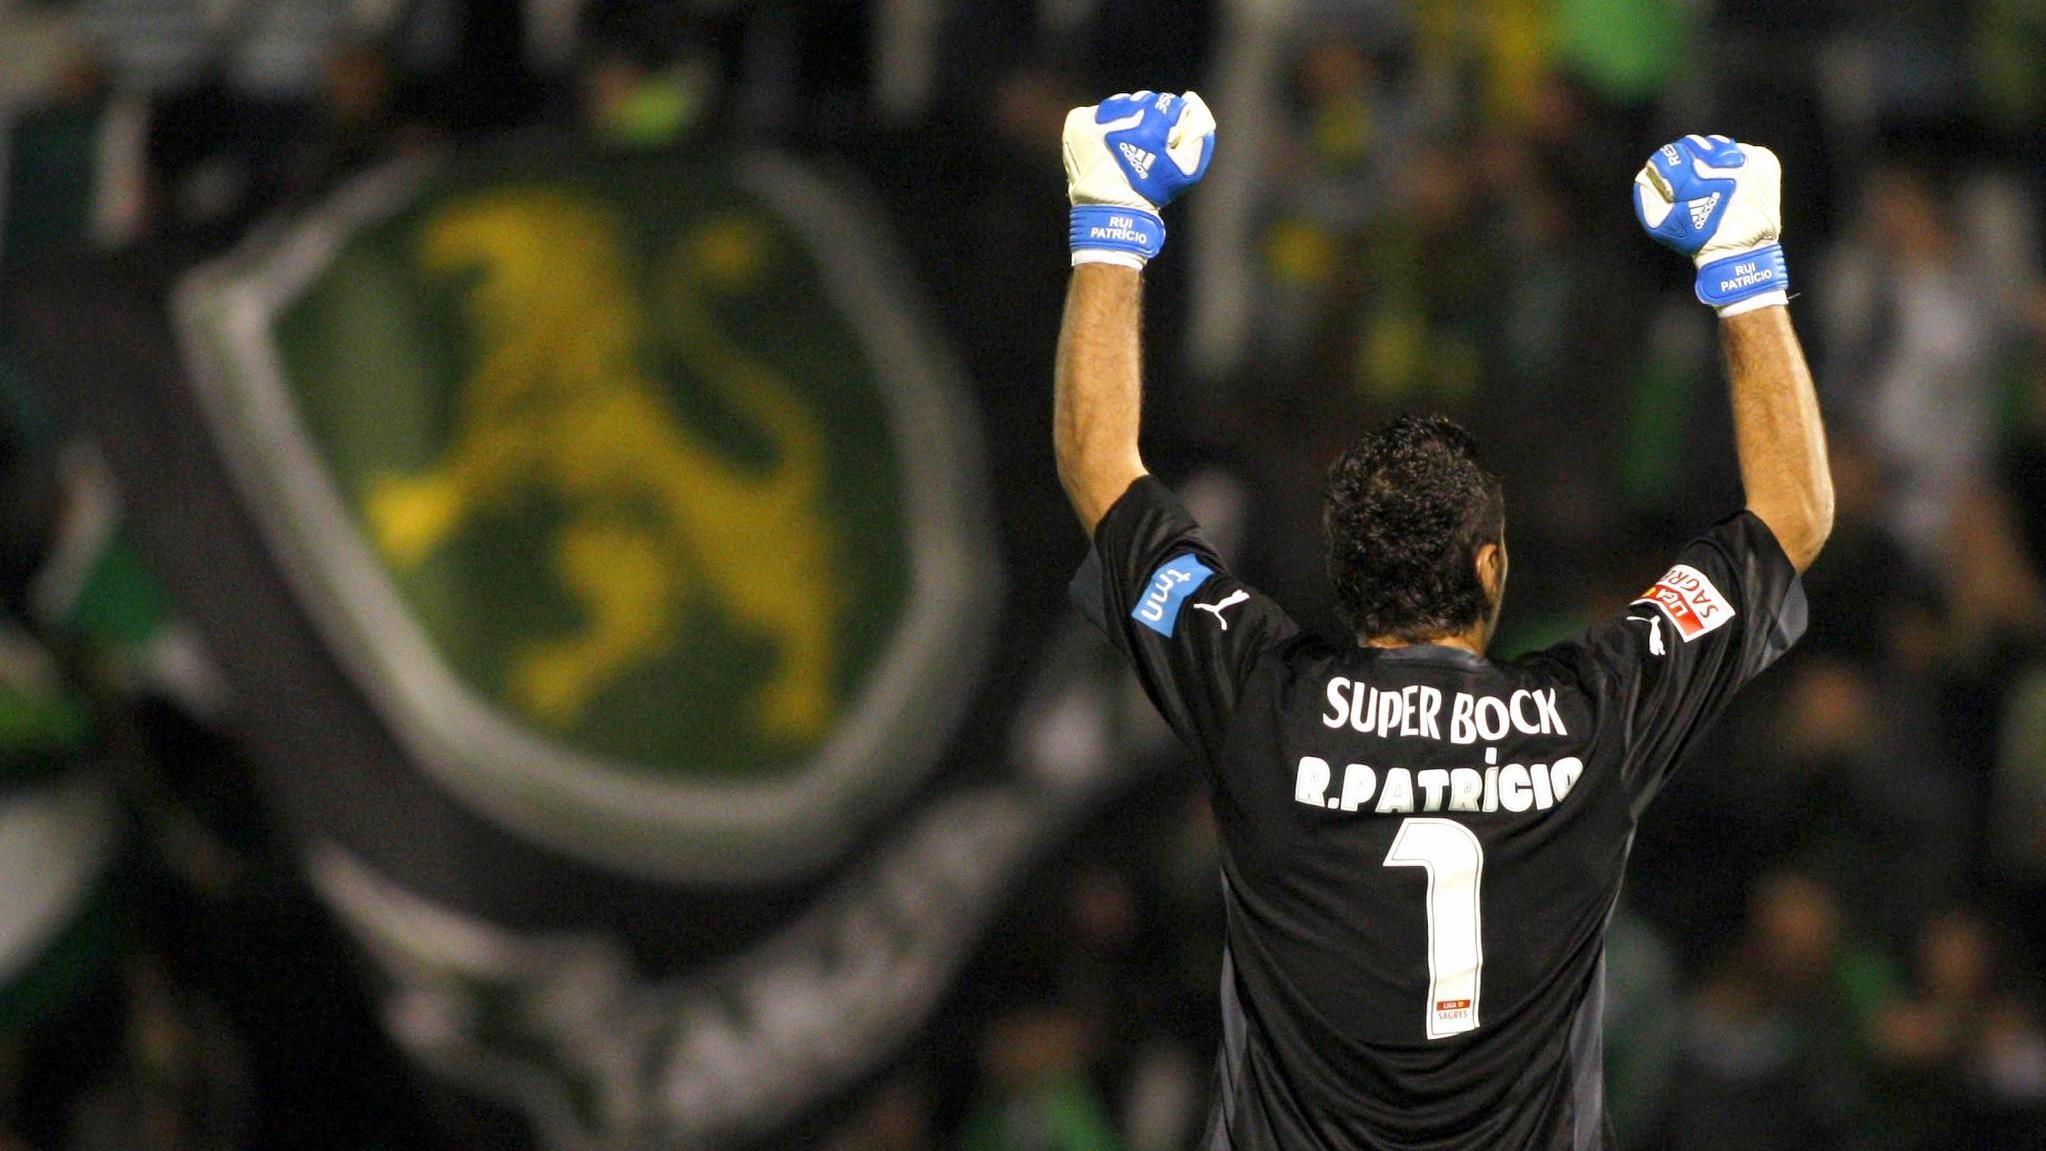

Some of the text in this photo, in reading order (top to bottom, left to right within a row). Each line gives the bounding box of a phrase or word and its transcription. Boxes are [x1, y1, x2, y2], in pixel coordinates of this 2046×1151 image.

[1119, 142, 1149, 180] adidas
[1090, 227, 1148, 245] PATRÍCIO
[1109, 216, 1133, 229] RUI
[1720, 269, 1773, 293] PATRÍCIO
[1735, 262, 1756, 277] RUI
[1141, 569, 1192, 621] tmn
[1322, 676, 1568, 744] SUPER BOCK
[1382, 817, 1484, 1040] 1
